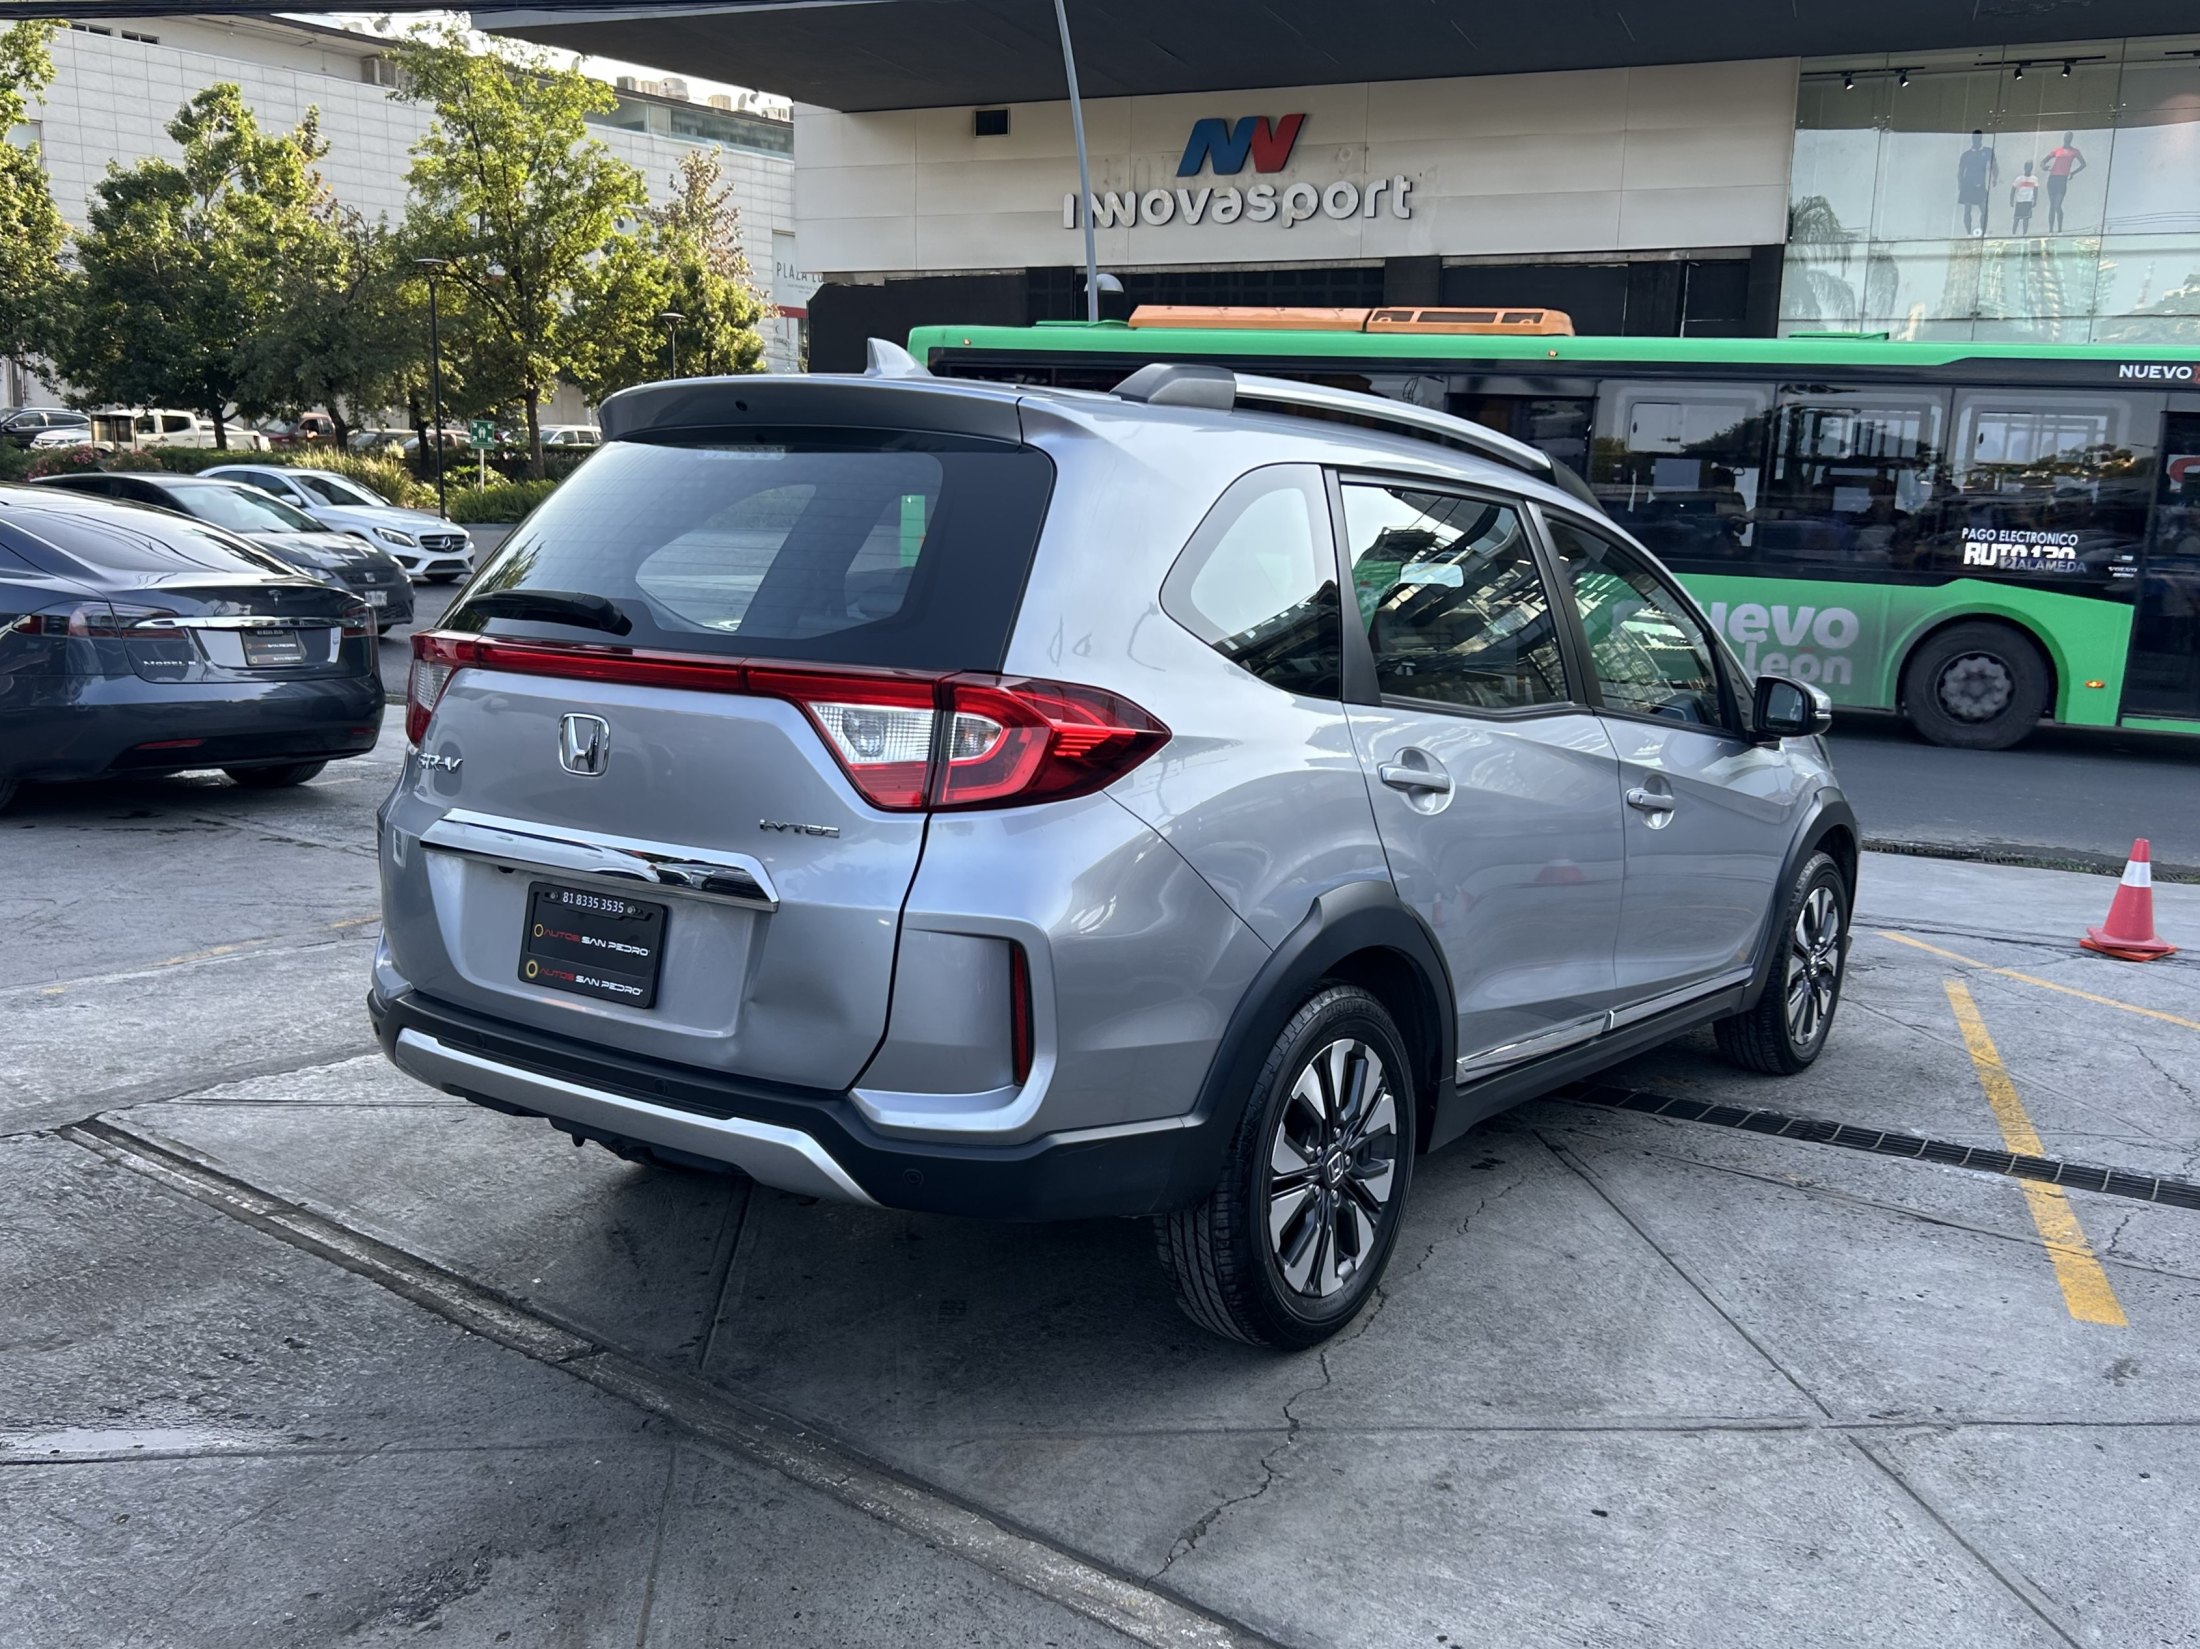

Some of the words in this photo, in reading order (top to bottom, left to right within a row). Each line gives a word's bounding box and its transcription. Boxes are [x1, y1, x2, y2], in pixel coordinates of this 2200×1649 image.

[2118, 364, 2192, 379] NUEVO
[1961, 527, 1997, 541] PAGO
[1999, 529, 2078, 546] ELECTRONICO
[2016, 559, 2087, 573] ALAMEDA
[562, 892, 574, 904] 81
[576, 894, 599, 909] 8335
[600, 899, 625, 914] 3535
[543, 928, 580, 942] AUTOS
[581, 935, 606, 948] SAN
[607, 941, 649, 957] PEDRO
[575, 975, 600, 988] SAN
[600, 980, 642, 996] PEDRO
